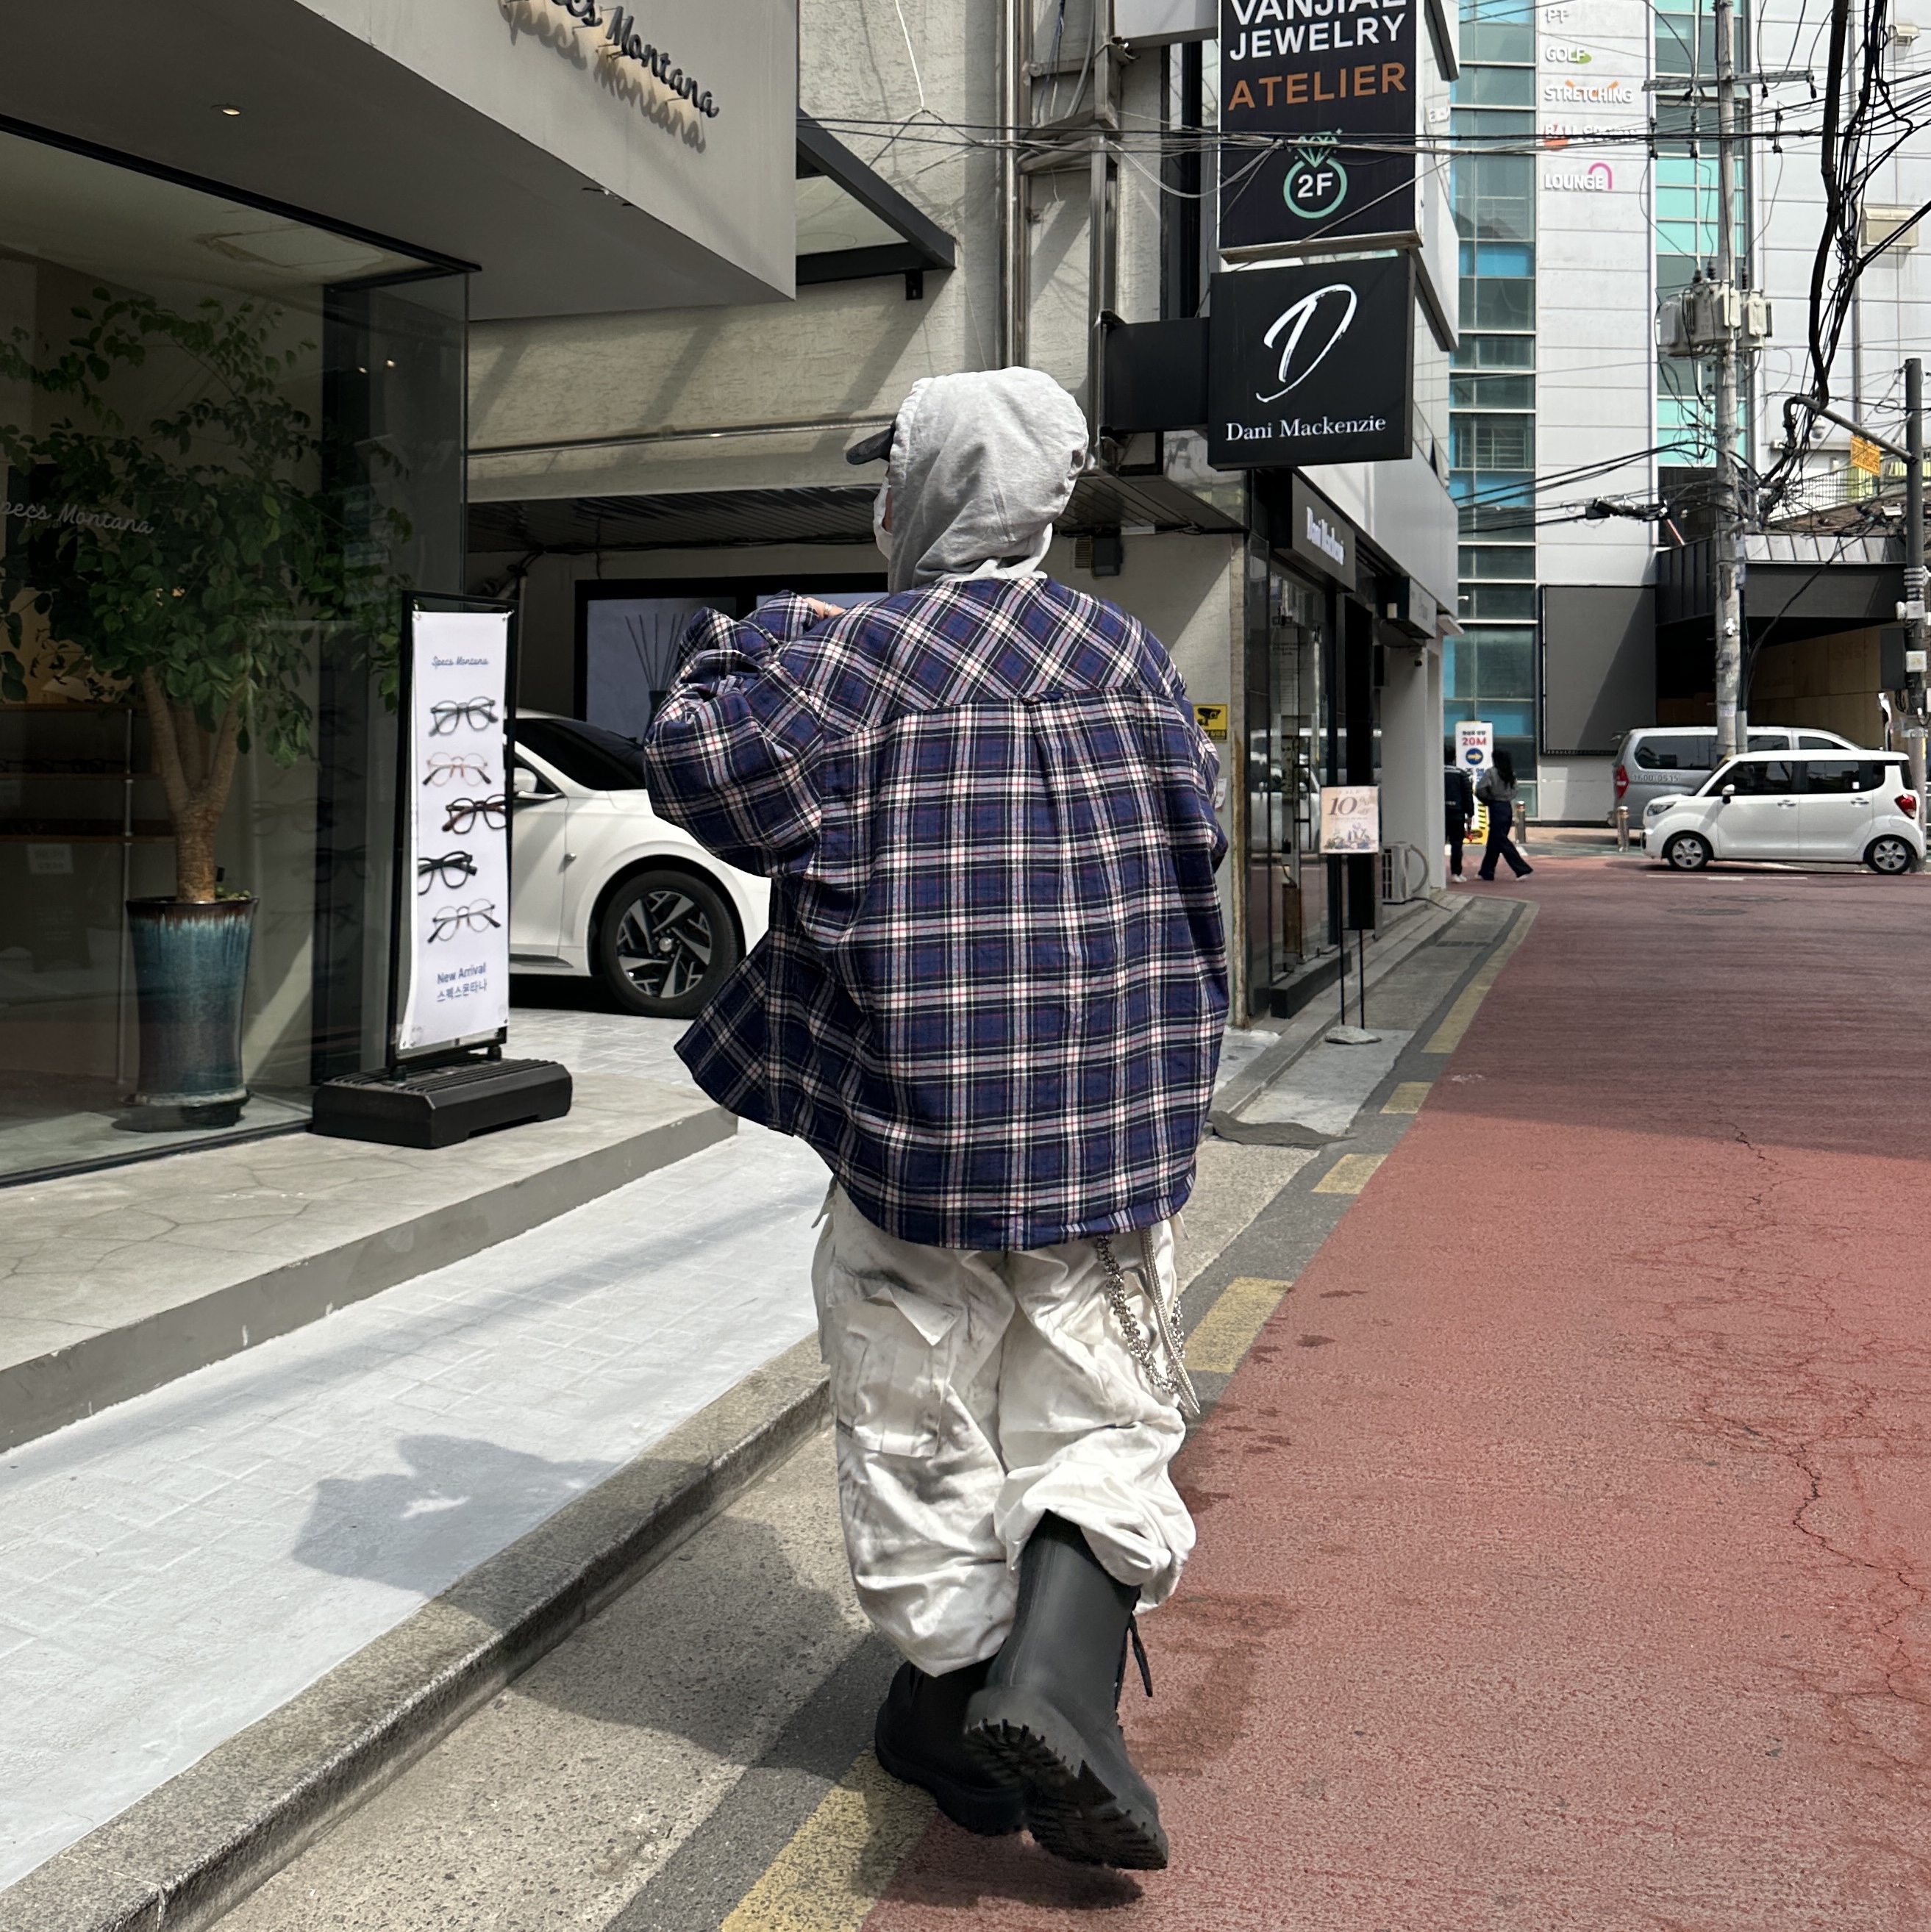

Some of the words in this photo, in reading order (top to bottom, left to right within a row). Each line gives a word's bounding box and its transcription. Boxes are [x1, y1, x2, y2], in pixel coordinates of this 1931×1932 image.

[1232, 0, 1407, 26] VANJIA
[1546, 8, 1569, 24] PT
[1229, 13, 1406, 61] JEWELRY
[605, 6, 719, 118] Montana
[1546, 46, 1586, 62] GOLF
[1228, 62, 1407, 111] ATELIER
[1545, 86, 1634, 103] STRETCHING
[1297, 172, 1334, 198] 2F
[1545, 174, 1605, 190] LOUNGE
[1256, 283, 1357, 403] D
[1226, 422, 1272, 441] Dani
[1279, 415, 1386, 437] Mackenzie
[58, 503, 154, 534] Montana
[1462, 737, 1487, 746] 20M
[1327, 797, 1357, 815] 10
[438, 972, 456, 984] New
[458, 962, 486, 978] Arrival
